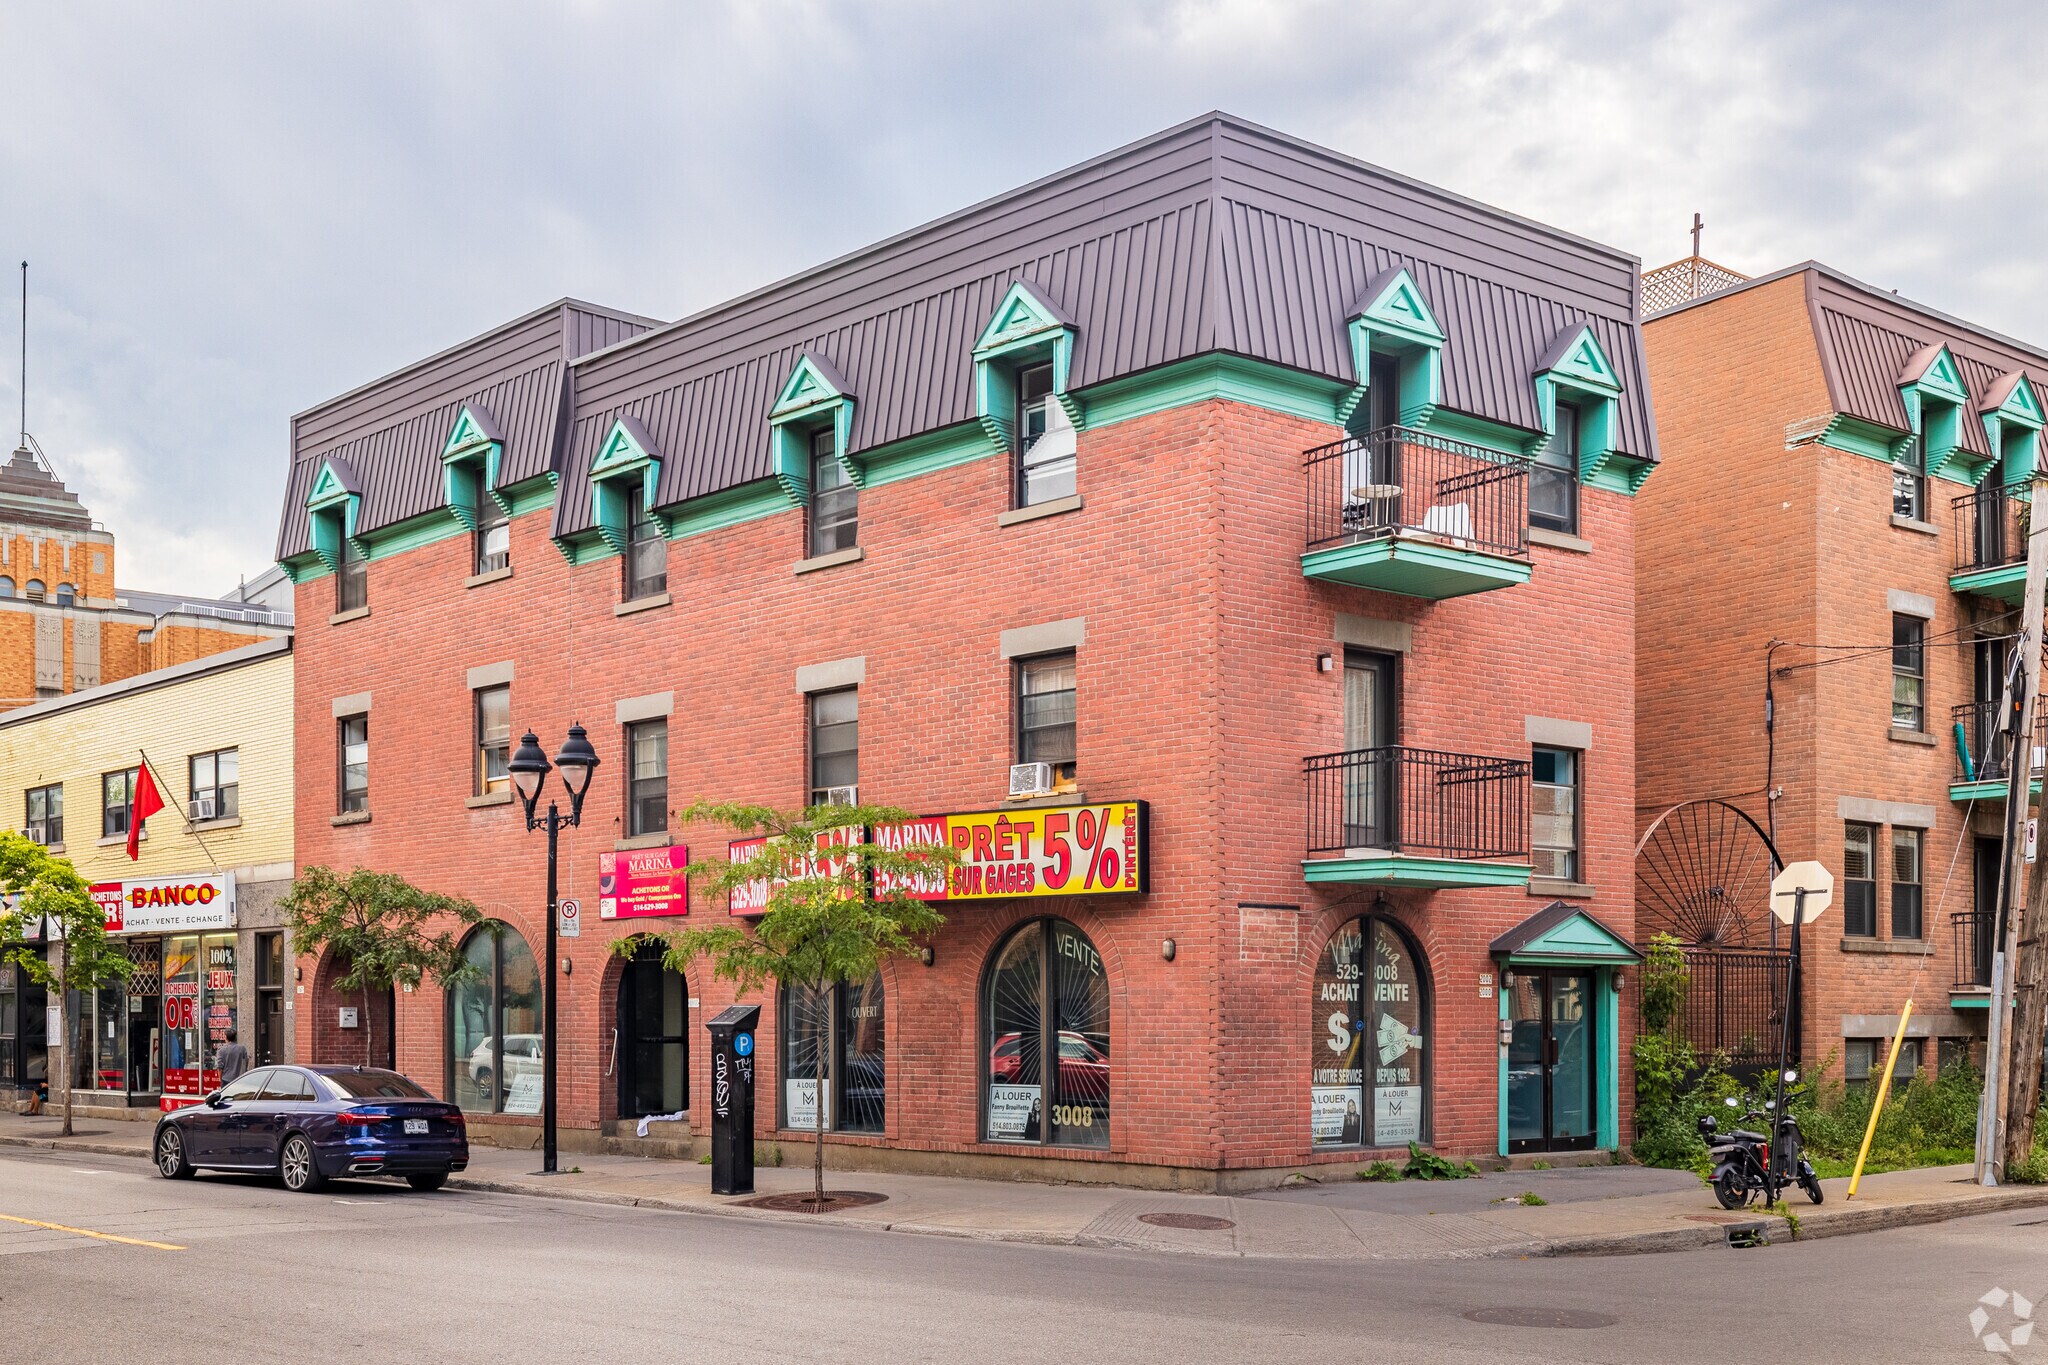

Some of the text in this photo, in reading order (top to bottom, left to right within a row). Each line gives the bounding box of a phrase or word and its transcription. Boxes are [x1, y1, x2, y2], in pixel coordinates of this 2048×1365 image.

[875, 822, 945, 852] MARINA
[951, 814, 1035, 863] PRÊT
[1042, 808, 1120, 890] 5%
[1124, 805, 1137, 888] D'INTÉRÊT
[628, 857, 673, 872] MARINA
[952, 862, 1035, 897] SUR GAGES
[90, 890, 123, 902] ACHETONS
[132, 882, 215, 909] BANCO
[632, 885, 670, 895] ACHETONS OR
[125, 914, 223, 927] ACHAT VENTE ECHANGE
[1056, 931, 1100, 977] VENTE
[1323, 928, 1401, 966] Maina
[210, 948, 233, 964] 100%
[207, 970, 234, 990] JEUX
[1336, 963, 1398, 981] 529-008
[165, 981, 198, 996] ACHETONS
[1320, 982, 1409, 1002] ACHAT VENTE
[165, 995, 194, 1030] OR
[851, 1005, 878, 1019] OUVERT
[740, 1036, 749, 1052] P
[1318, 1068, 1338, 1083] VOTRE
[1338, 1068, 1363, 1083] SERVICE
[1376, 1067, 1411, 1083] DEPUIS 1992
[994, 1090, 1032, 1101] À LOUER
[1318, 1094, 1346, 1104] LOUER
[1382, 1089, 1409, 1098] À LOUER
[1052, 1104, 1093, 1128] 3008
[1377, 1128, 1415, 1137] 14-495-3535
